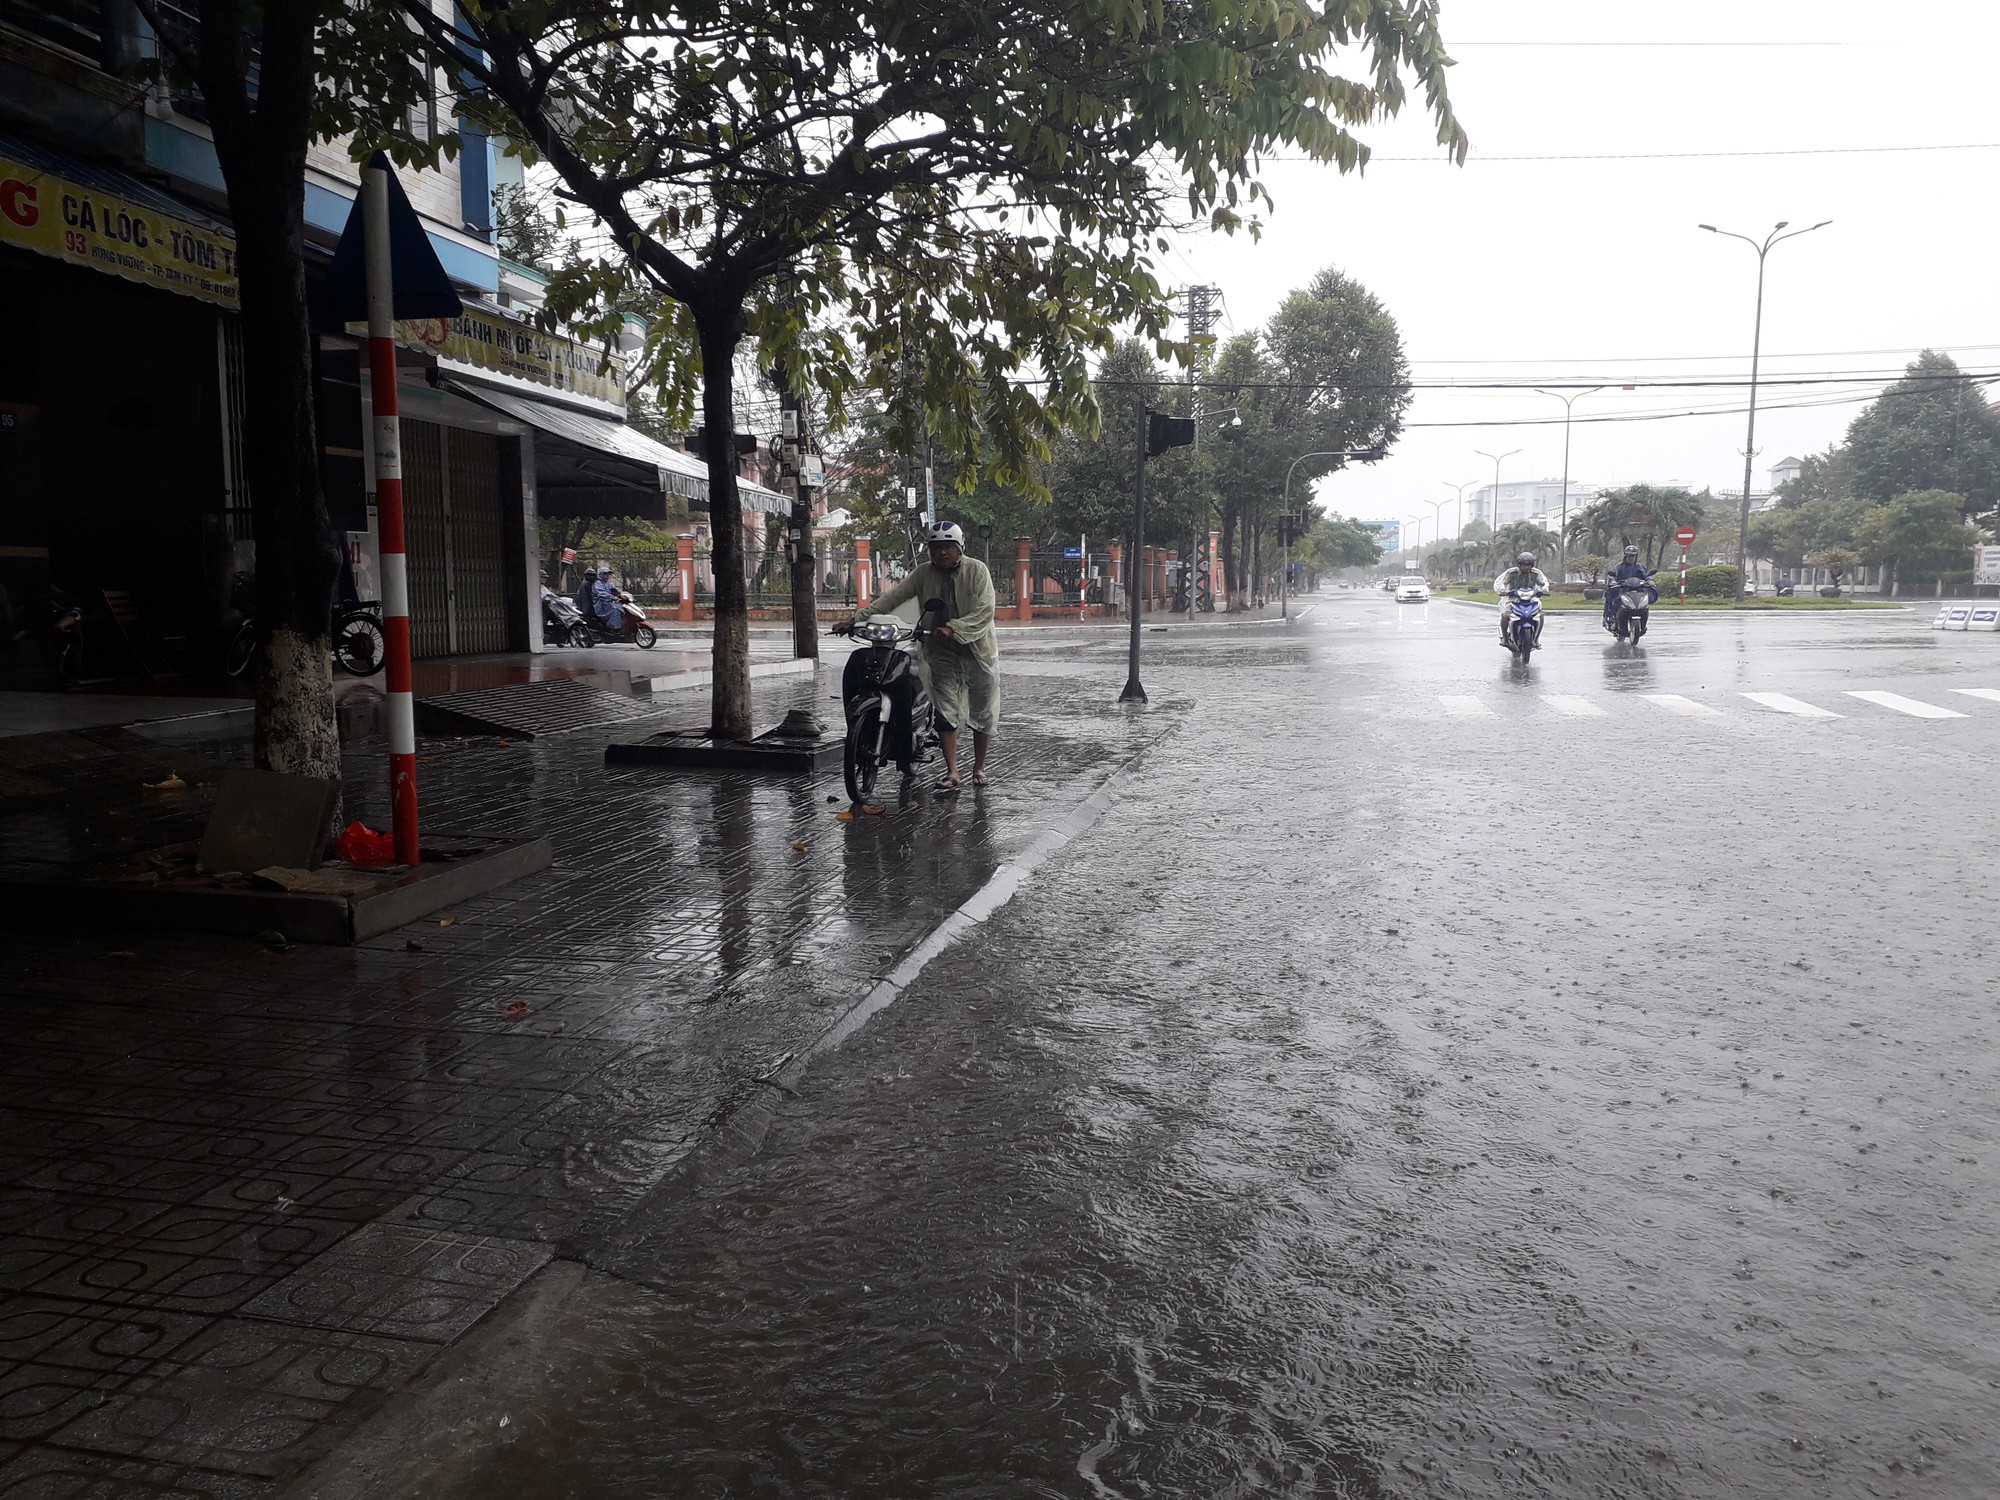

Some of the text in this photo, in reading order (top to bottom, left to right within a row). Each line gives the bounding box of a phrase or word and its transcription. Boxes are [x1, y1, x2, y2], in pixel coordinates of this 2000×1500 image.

[62, 194, 96, 233] CÁ
[103, 207, 147, 248] LÓC
[170, 230, 216, 270] TÔM
[65, 230, 86, 254] 93
[453, 314, 492, 344] BÁNH
